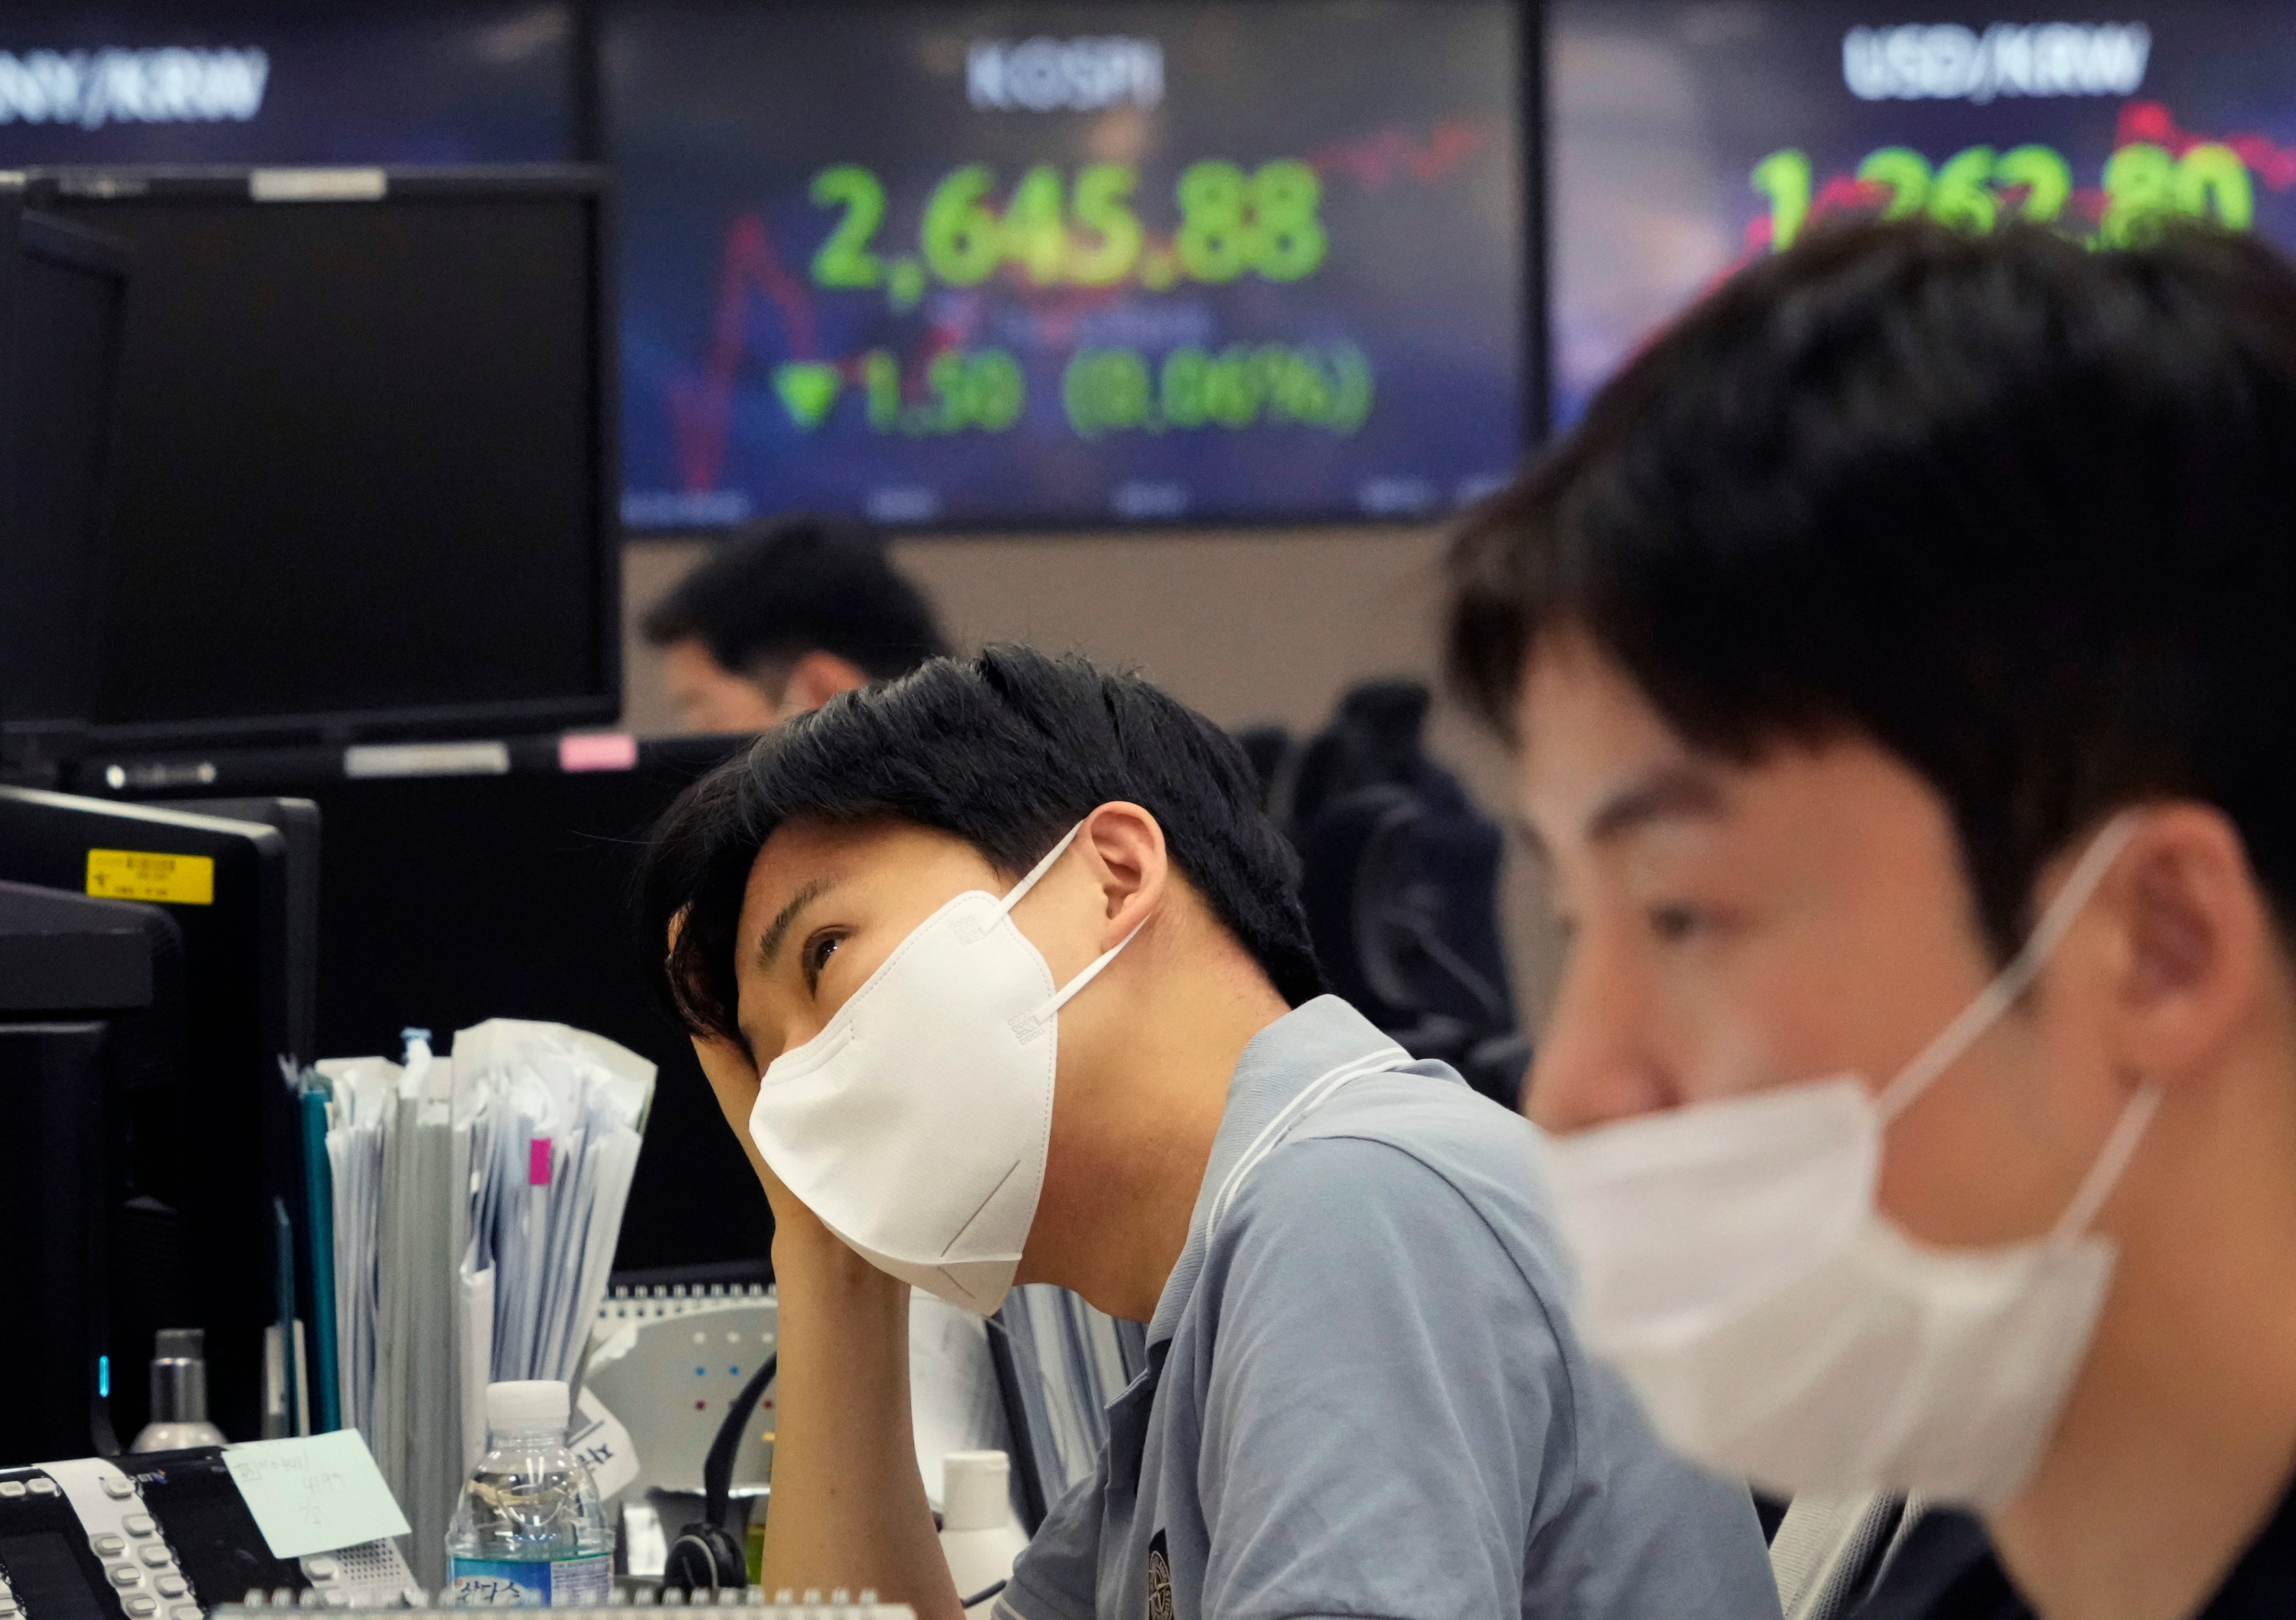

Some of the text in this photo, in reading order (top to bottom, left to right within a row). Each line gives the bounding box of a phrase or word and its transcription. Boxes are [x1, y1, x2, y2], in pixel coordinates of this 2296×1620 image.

[967, 37, 1164, 110] KOSPI
[1844, 22, 2152, 103] USD/KRW
[811, 160, 1326, 307] 2,645.88
[866, 342, 1373, 440] 1.50 (0.06%)
